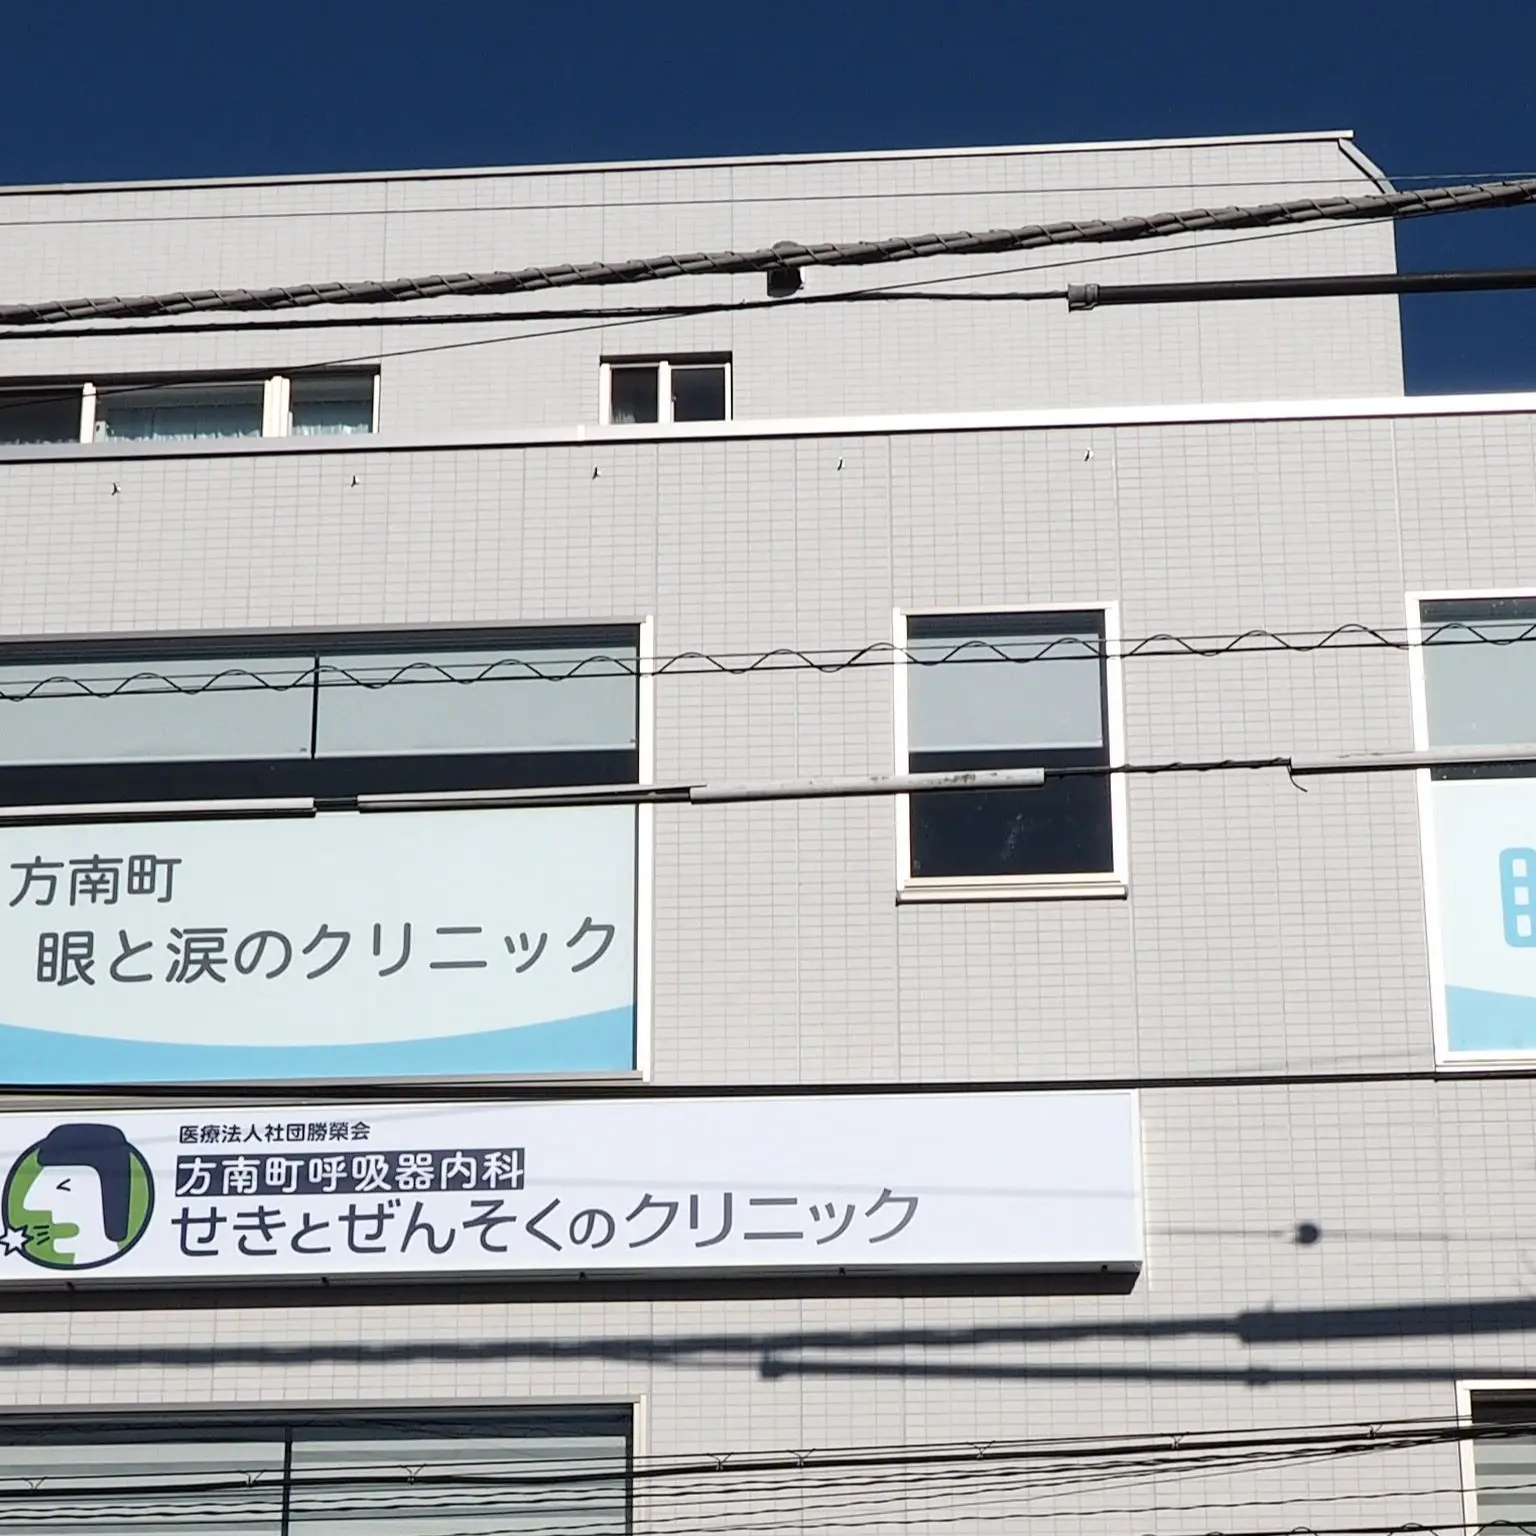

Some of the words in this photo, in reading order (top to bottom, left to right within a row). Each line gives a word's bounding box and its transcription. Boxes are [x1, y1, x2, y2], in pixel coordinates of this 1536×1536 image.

[8, 854, 183, 908] 方南町
[35, 915, 617, 988] 眼と涙のクリニック
[175, 1150, 525, 1197] 方南町呼吸器内科
[170, 1187, 920, 1259] せきとぜんそくのクリニック
